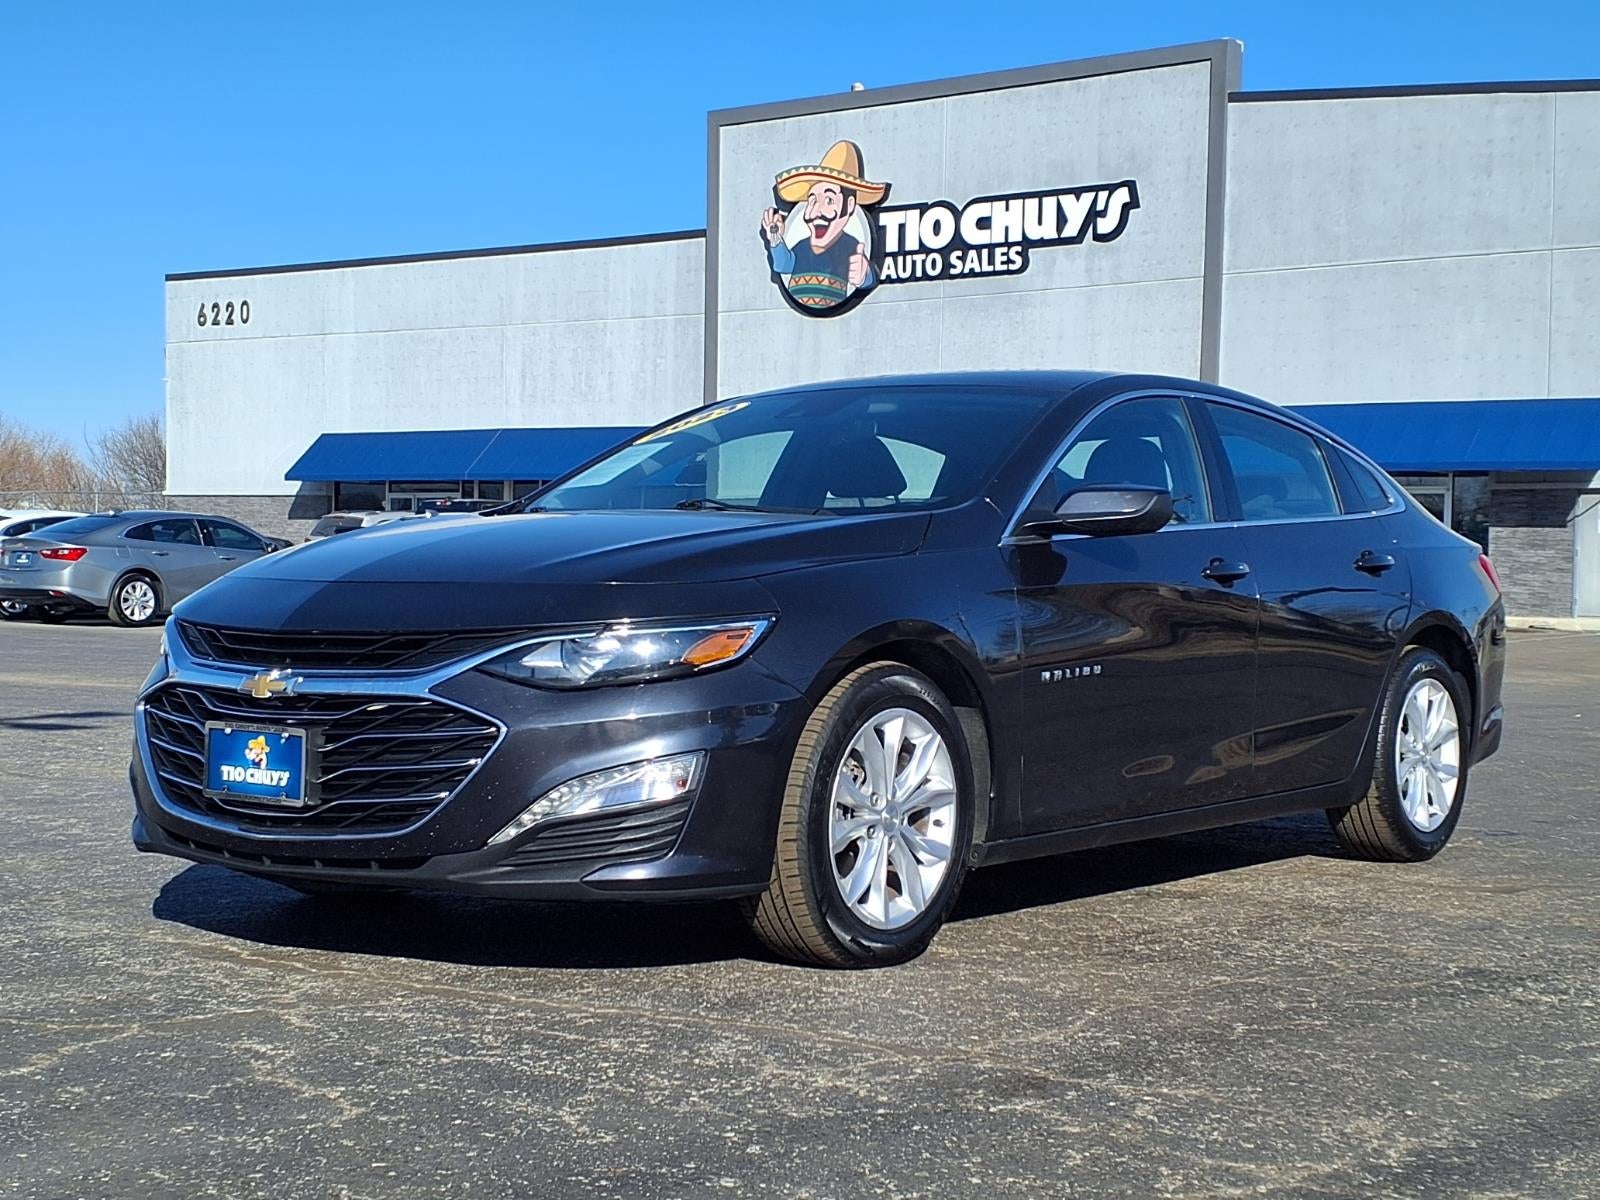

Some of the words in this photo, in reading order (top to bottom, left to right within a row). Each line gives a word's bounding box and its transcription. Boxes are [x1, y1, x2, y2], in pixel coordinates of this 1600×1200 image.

[879, 206, 956, 253] TIO
[960, 186, 1131, 247] CHUY'S
[880, 251, 943, 281] AUTO
[949, 246, 1023, 275] SALES
[197, 299, 250, 327] 6220
[1040, 664, 1102, 682] MALIBU
[220, 765, 245, 782] TIO
[245, 767, 290, 787] CHUY'S
